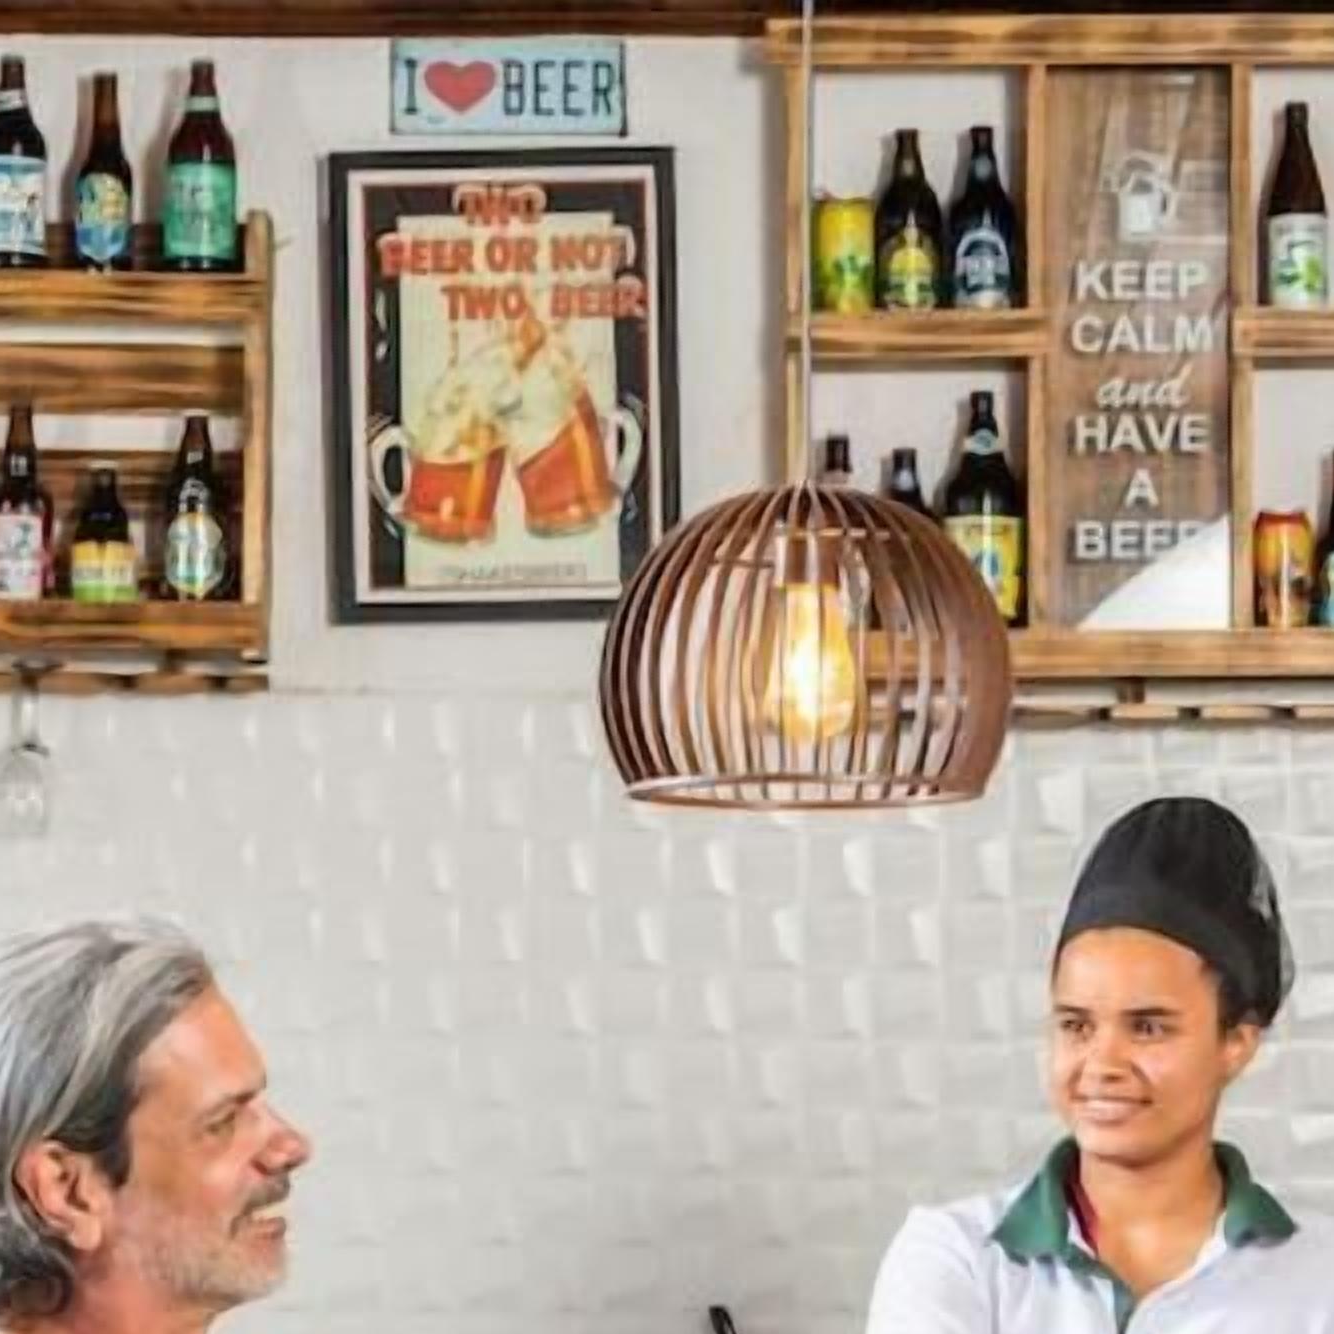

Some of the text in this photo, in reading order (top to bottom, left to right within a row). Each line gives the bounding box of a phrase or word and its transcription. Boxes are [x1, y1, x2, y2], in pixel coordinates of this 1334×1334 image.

[403, 57, 616, 117] I BEER
[379, 233, 627, 277] BEER OR NOT
[1075, 259, 1210, 301] KEEP
[1071, 312, 1215, 353] CALM
[1095, 362, 1193, 409] and
[1074, 411, 1211, 453] HAVE
[1124, 467, 1160, 508] A
